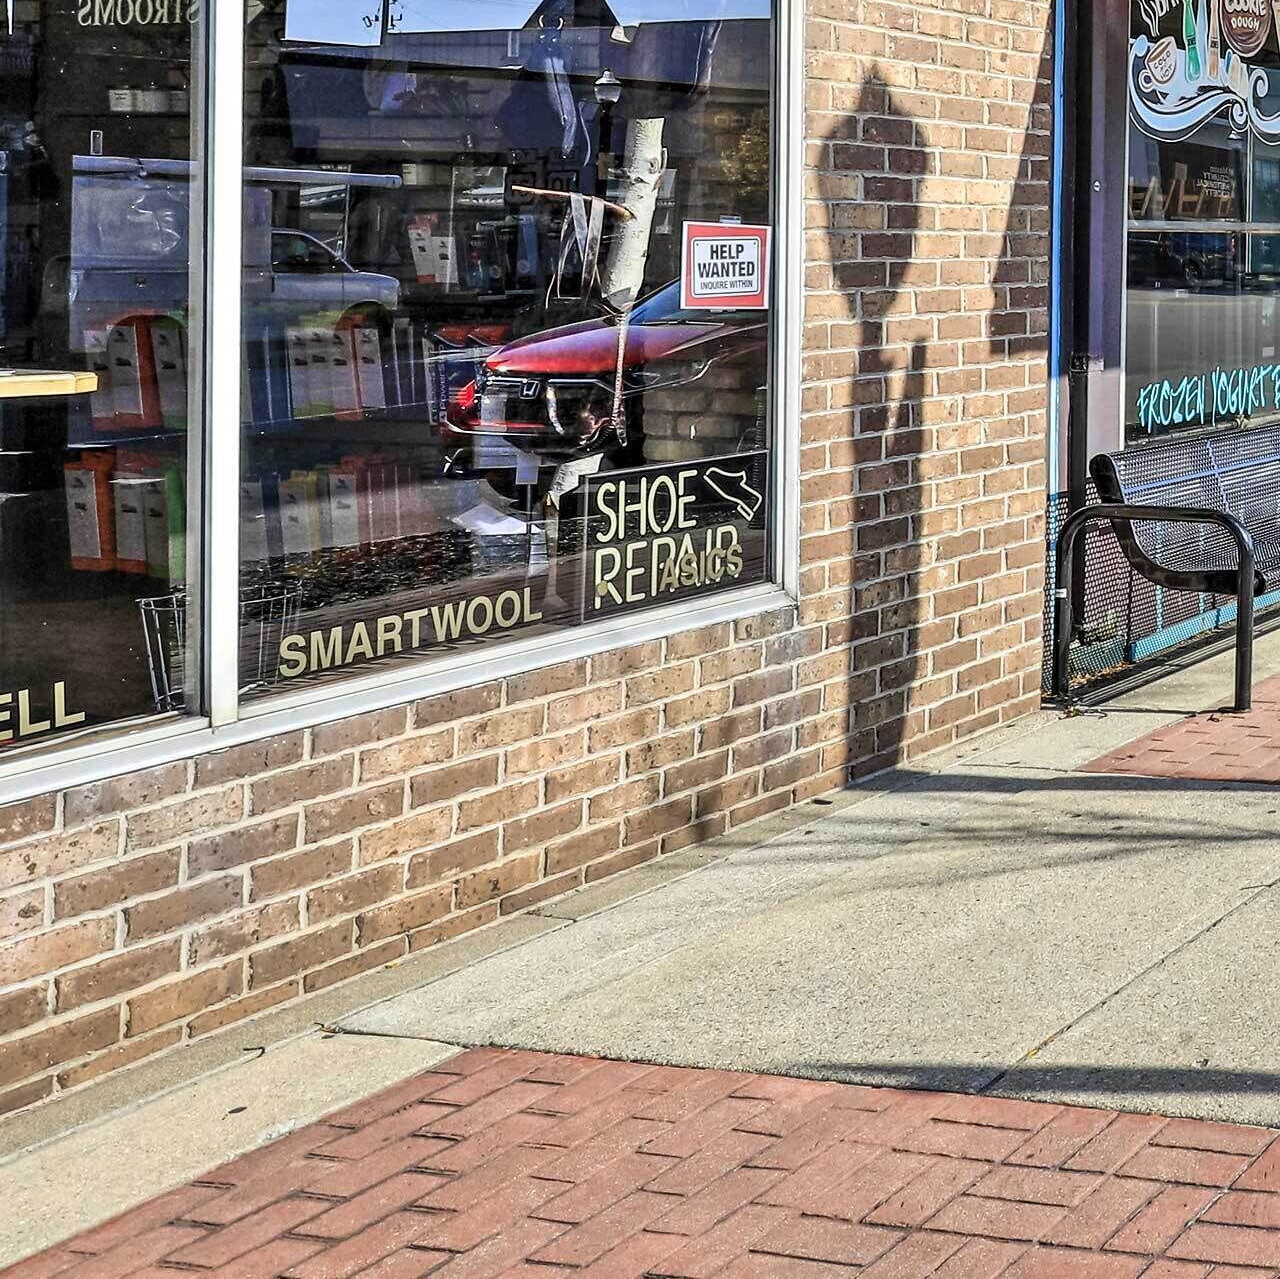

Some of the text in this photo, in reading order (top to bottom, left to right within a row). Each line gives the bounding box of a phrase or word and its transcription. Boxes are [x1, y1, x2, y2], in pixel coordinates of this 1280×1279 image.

[1231, 17, 1260, 31] DOUGH
[697, 261, 755, 279] WANTED
[710, 244, 744, 260] HELP
[700, 279, 753, 290] INQUIRE WITHIN
[1136, 375, 1205, 433] FROZEN
[1211, 364, 1273, 426] YOGURT
[596, 470, 698, 543] SHOE
[594, 525, 741, 610] REPAIR
[659, 543, 743, 592] ASICS
[279, 587, 543, 678] SMARTWOOL
